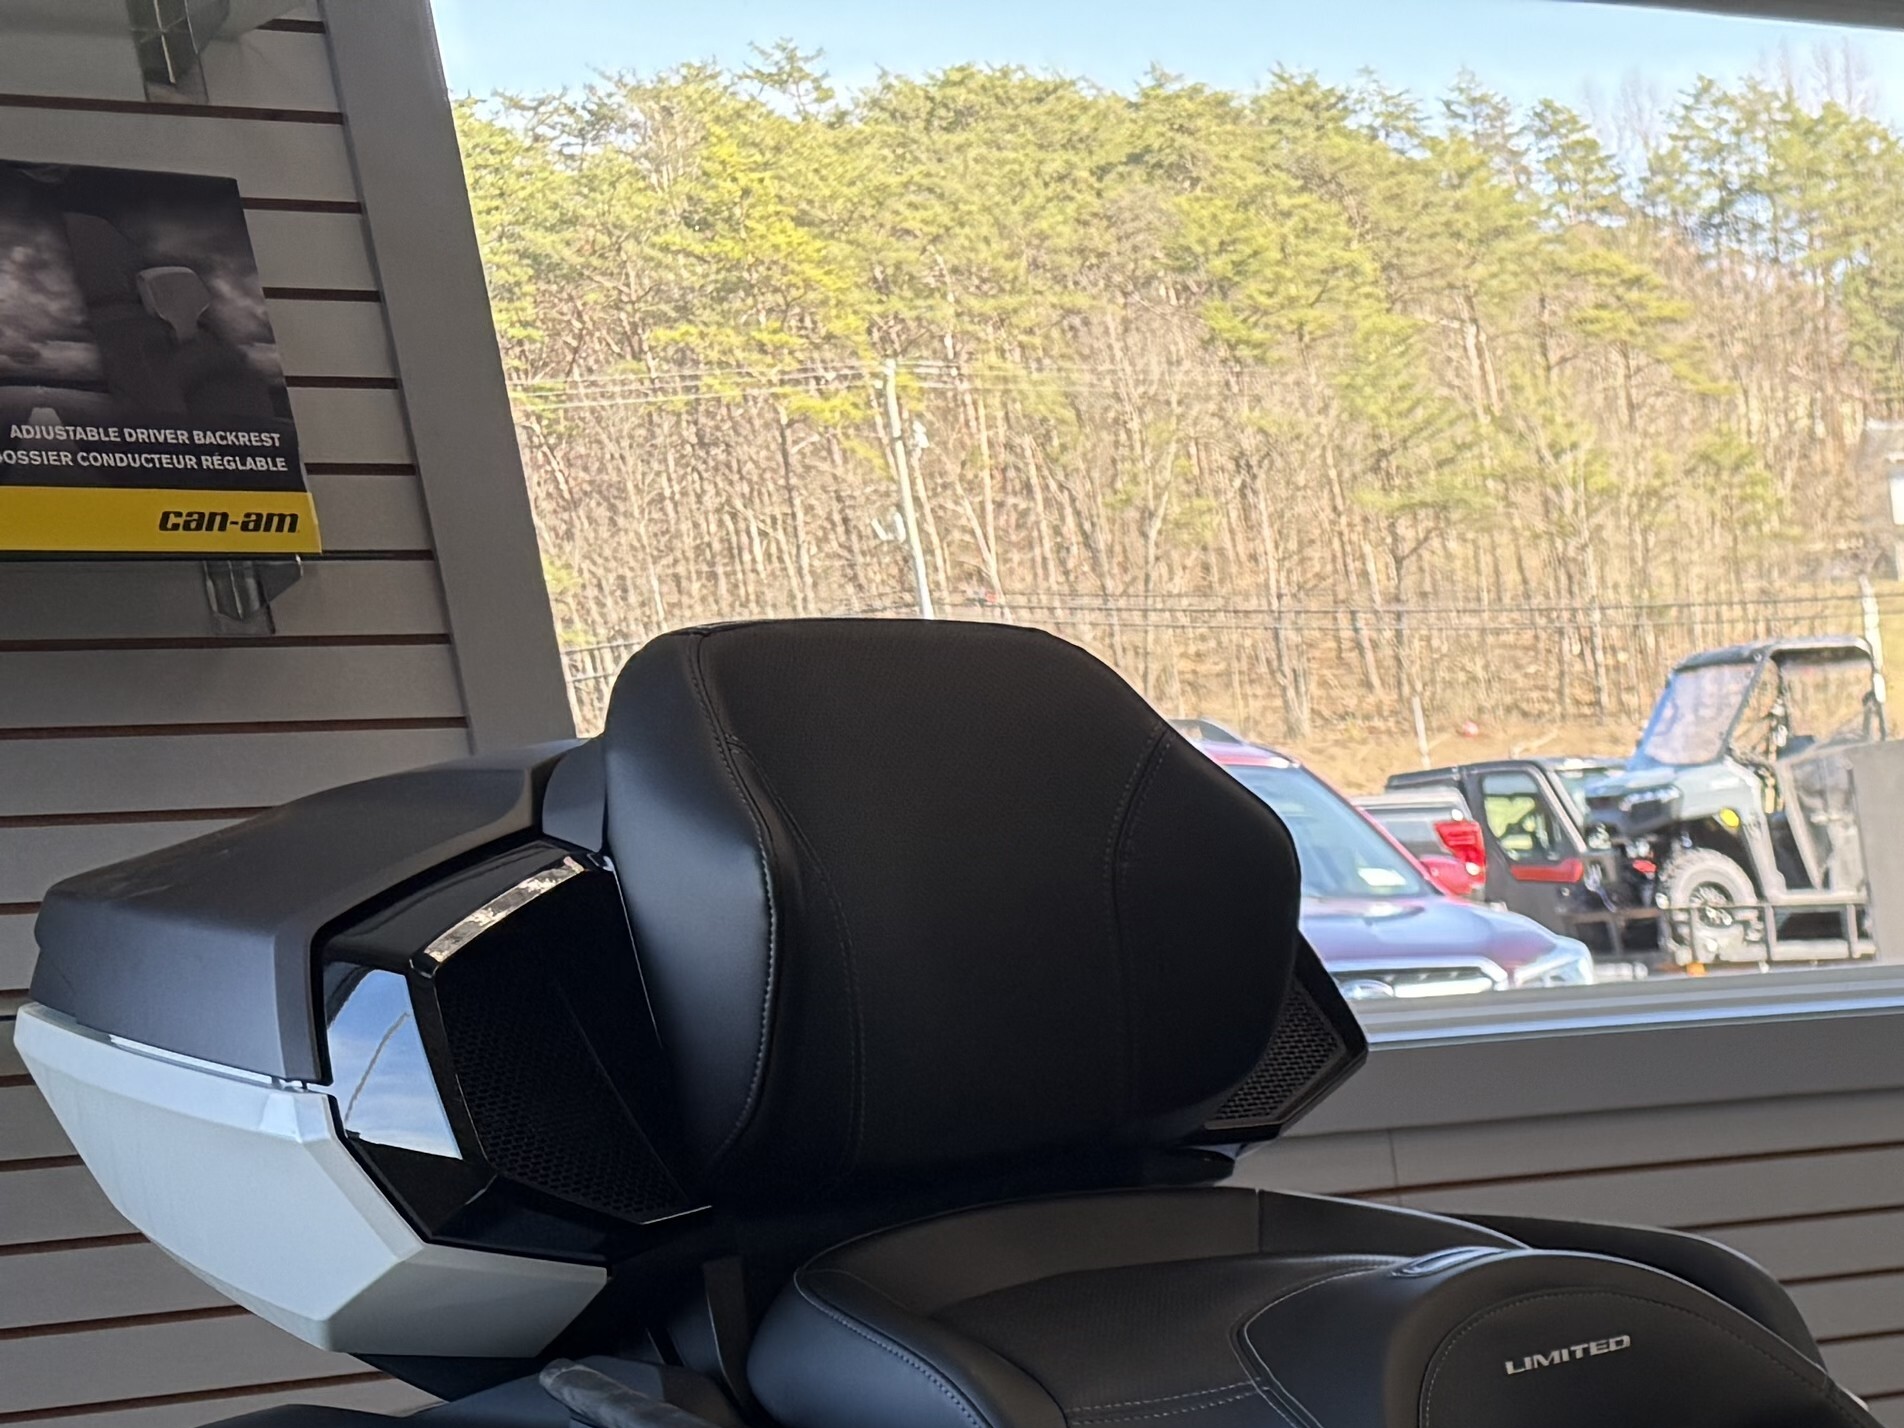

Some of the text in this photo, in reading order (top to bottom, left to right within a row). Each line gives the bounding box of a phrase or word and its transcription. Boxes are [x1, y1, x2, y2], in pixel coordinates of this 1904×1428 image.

[9, 424, 281, 447] ADJUSTABLE DRIVER BACKREST
[0, 450, 288, 471] OSSIER CONDUCTEUR RÉGLABLE
[158, 510, 299, 533] can-am
[1505, 1334, 1631, 1375] LIMITED
